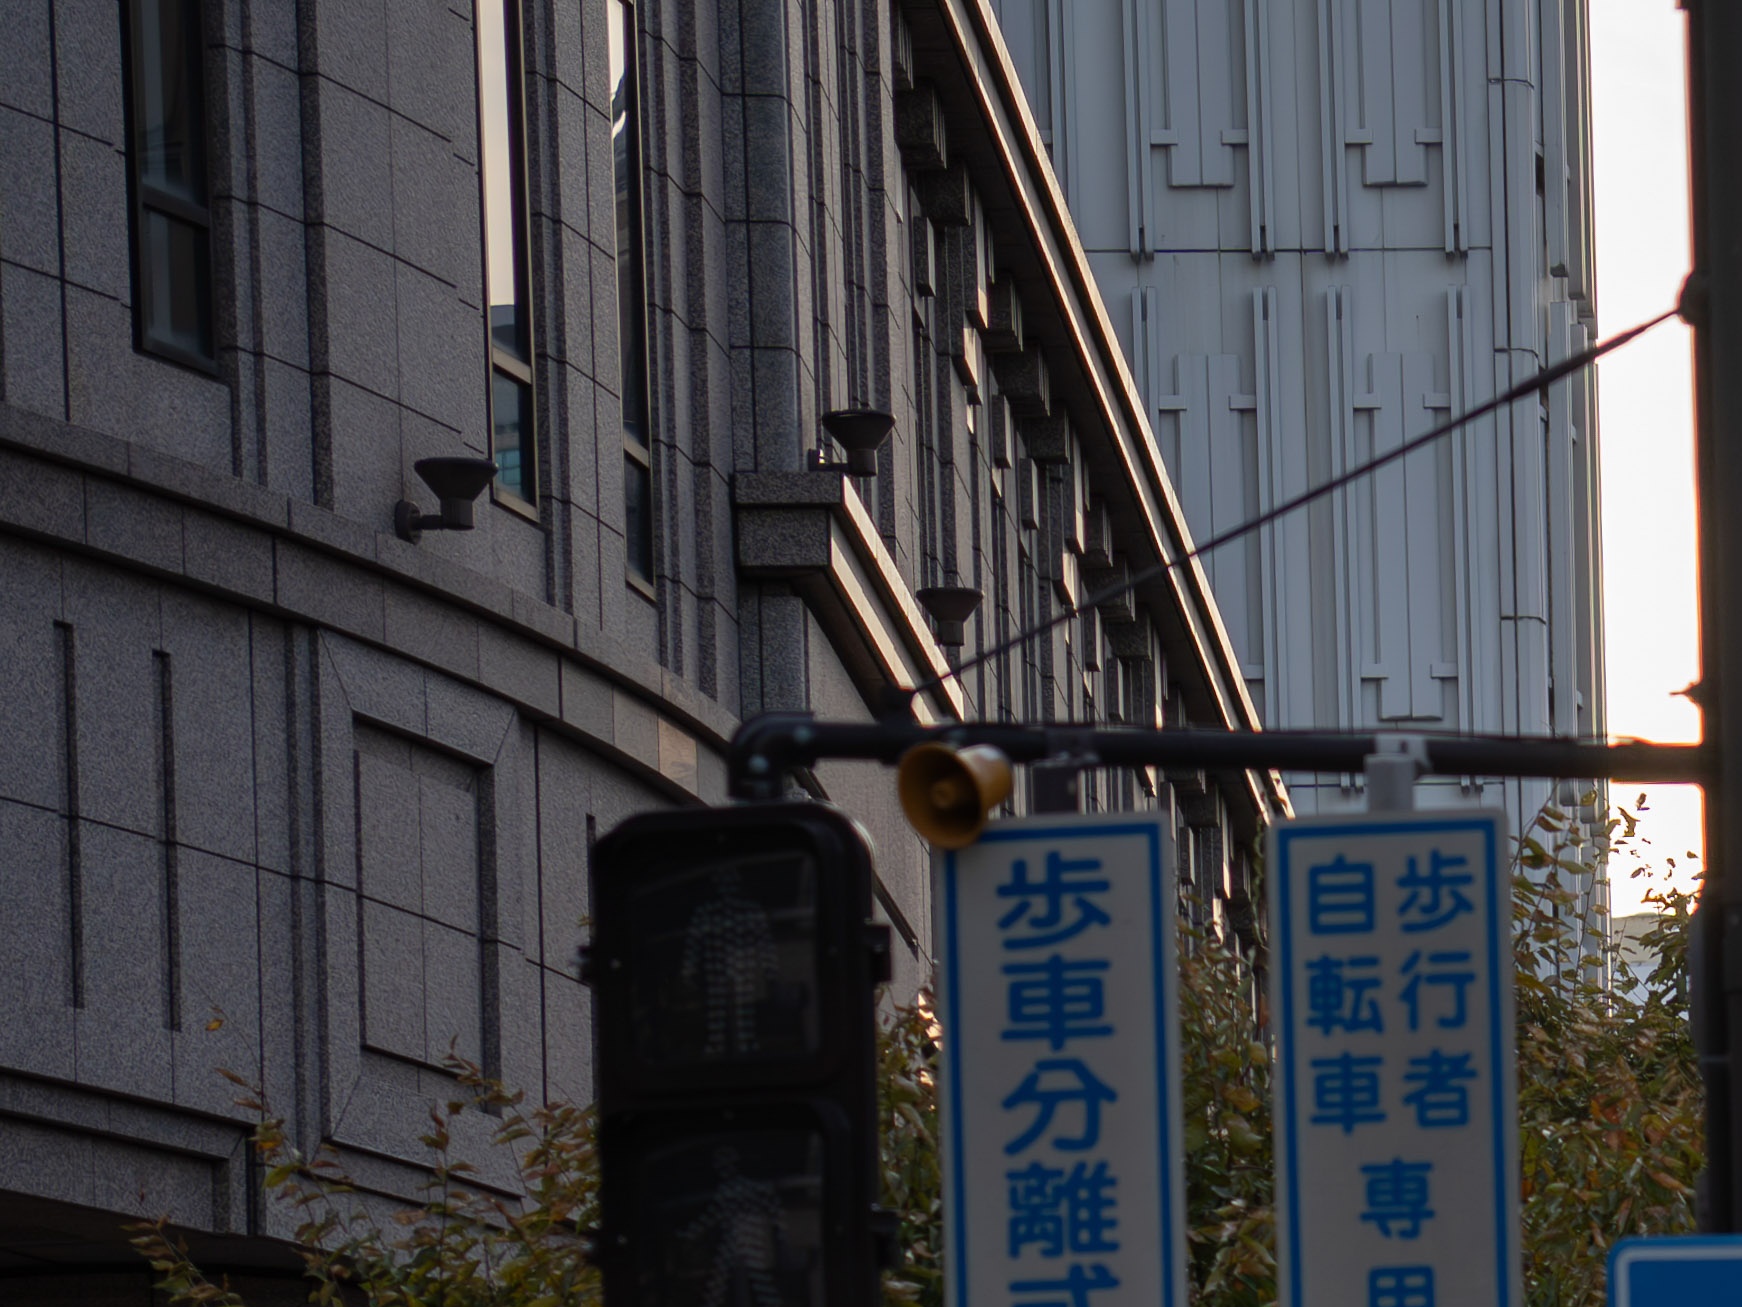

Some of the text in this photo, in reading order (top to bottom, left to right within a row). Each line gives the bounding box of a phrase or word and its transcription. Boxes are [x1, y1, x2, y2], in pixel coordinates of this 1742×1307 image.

[1306, 854, 1388, 1134] 自転車
[1394, 850, 1478, 1130] 歩行者
